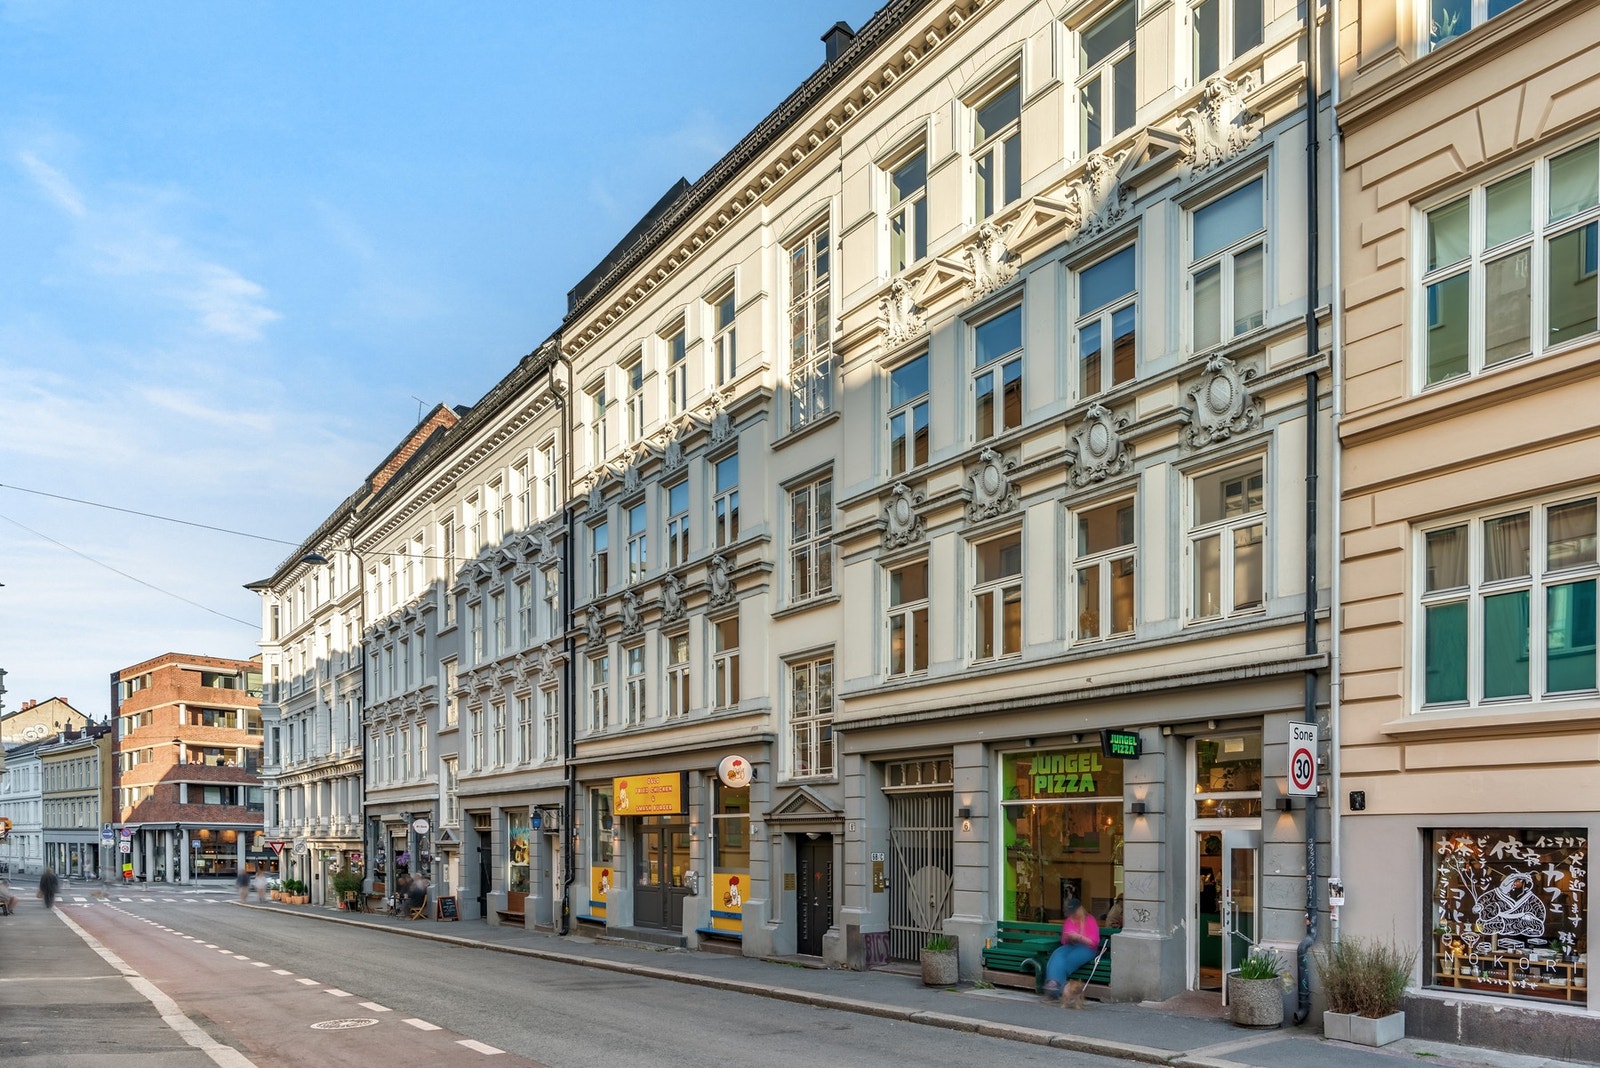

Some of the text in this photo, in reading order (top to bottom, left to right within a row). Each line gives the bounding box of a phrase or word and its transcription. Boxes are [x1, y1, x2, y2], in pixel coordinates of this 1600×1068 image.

[1110, 734, 1137, 746] JUNGEL
[1293, 727, 1313, 742] Sone
[1112, 744, 1135, 755] PIZZA
[1028, 752, 1103, 775] JUNGEL
[1296, 759, 1310, 779] 30
[650, 785, 672, 793] CHICKEN
[1034, 773, 1095, 794] PIZZA
[1437, 836, 1474, 857] お茶
[1535, 835, 1586, 848] インテリア
[1542, 863, 1564, 913] カフェ
[1450, 888, 1465, 935] コーヒー
[1444, 950, 1577, 974] NOKORI
